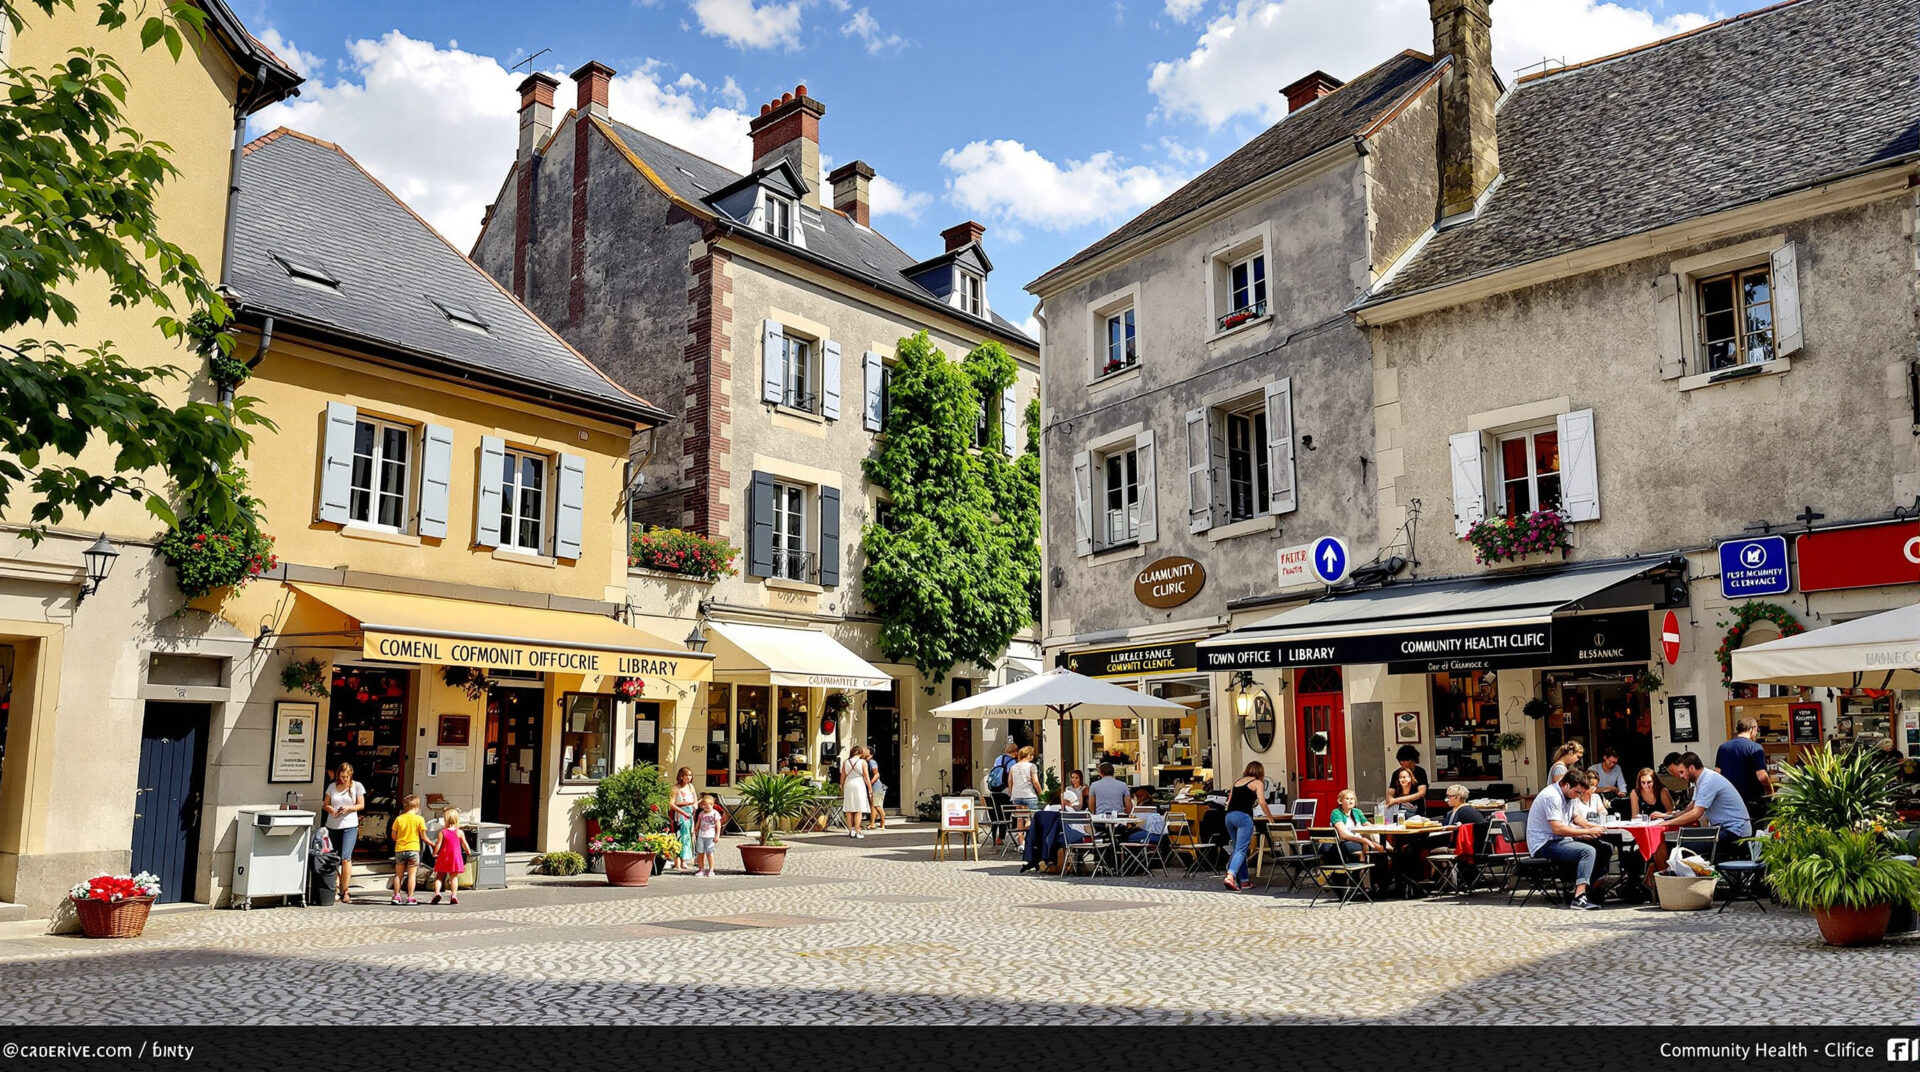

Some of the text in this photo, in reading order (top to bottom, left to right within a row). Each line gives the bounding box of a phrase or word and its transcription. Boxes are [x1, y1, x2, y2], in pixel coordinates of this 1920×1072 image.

[1401, 633, 1544, 653] COMMUNITY HEALTH CLIFIC
[380, 639, 442, 660] COMENL
[451, 645, 523, 665] COFMONIT
[619, 657, 678, 676] LIBRARY
[1208, 652, 1235, 665] TOWN
[1237, 650, 1271, 664] OFFICE
[1289, 647, 1335, 661] LIBRARY
